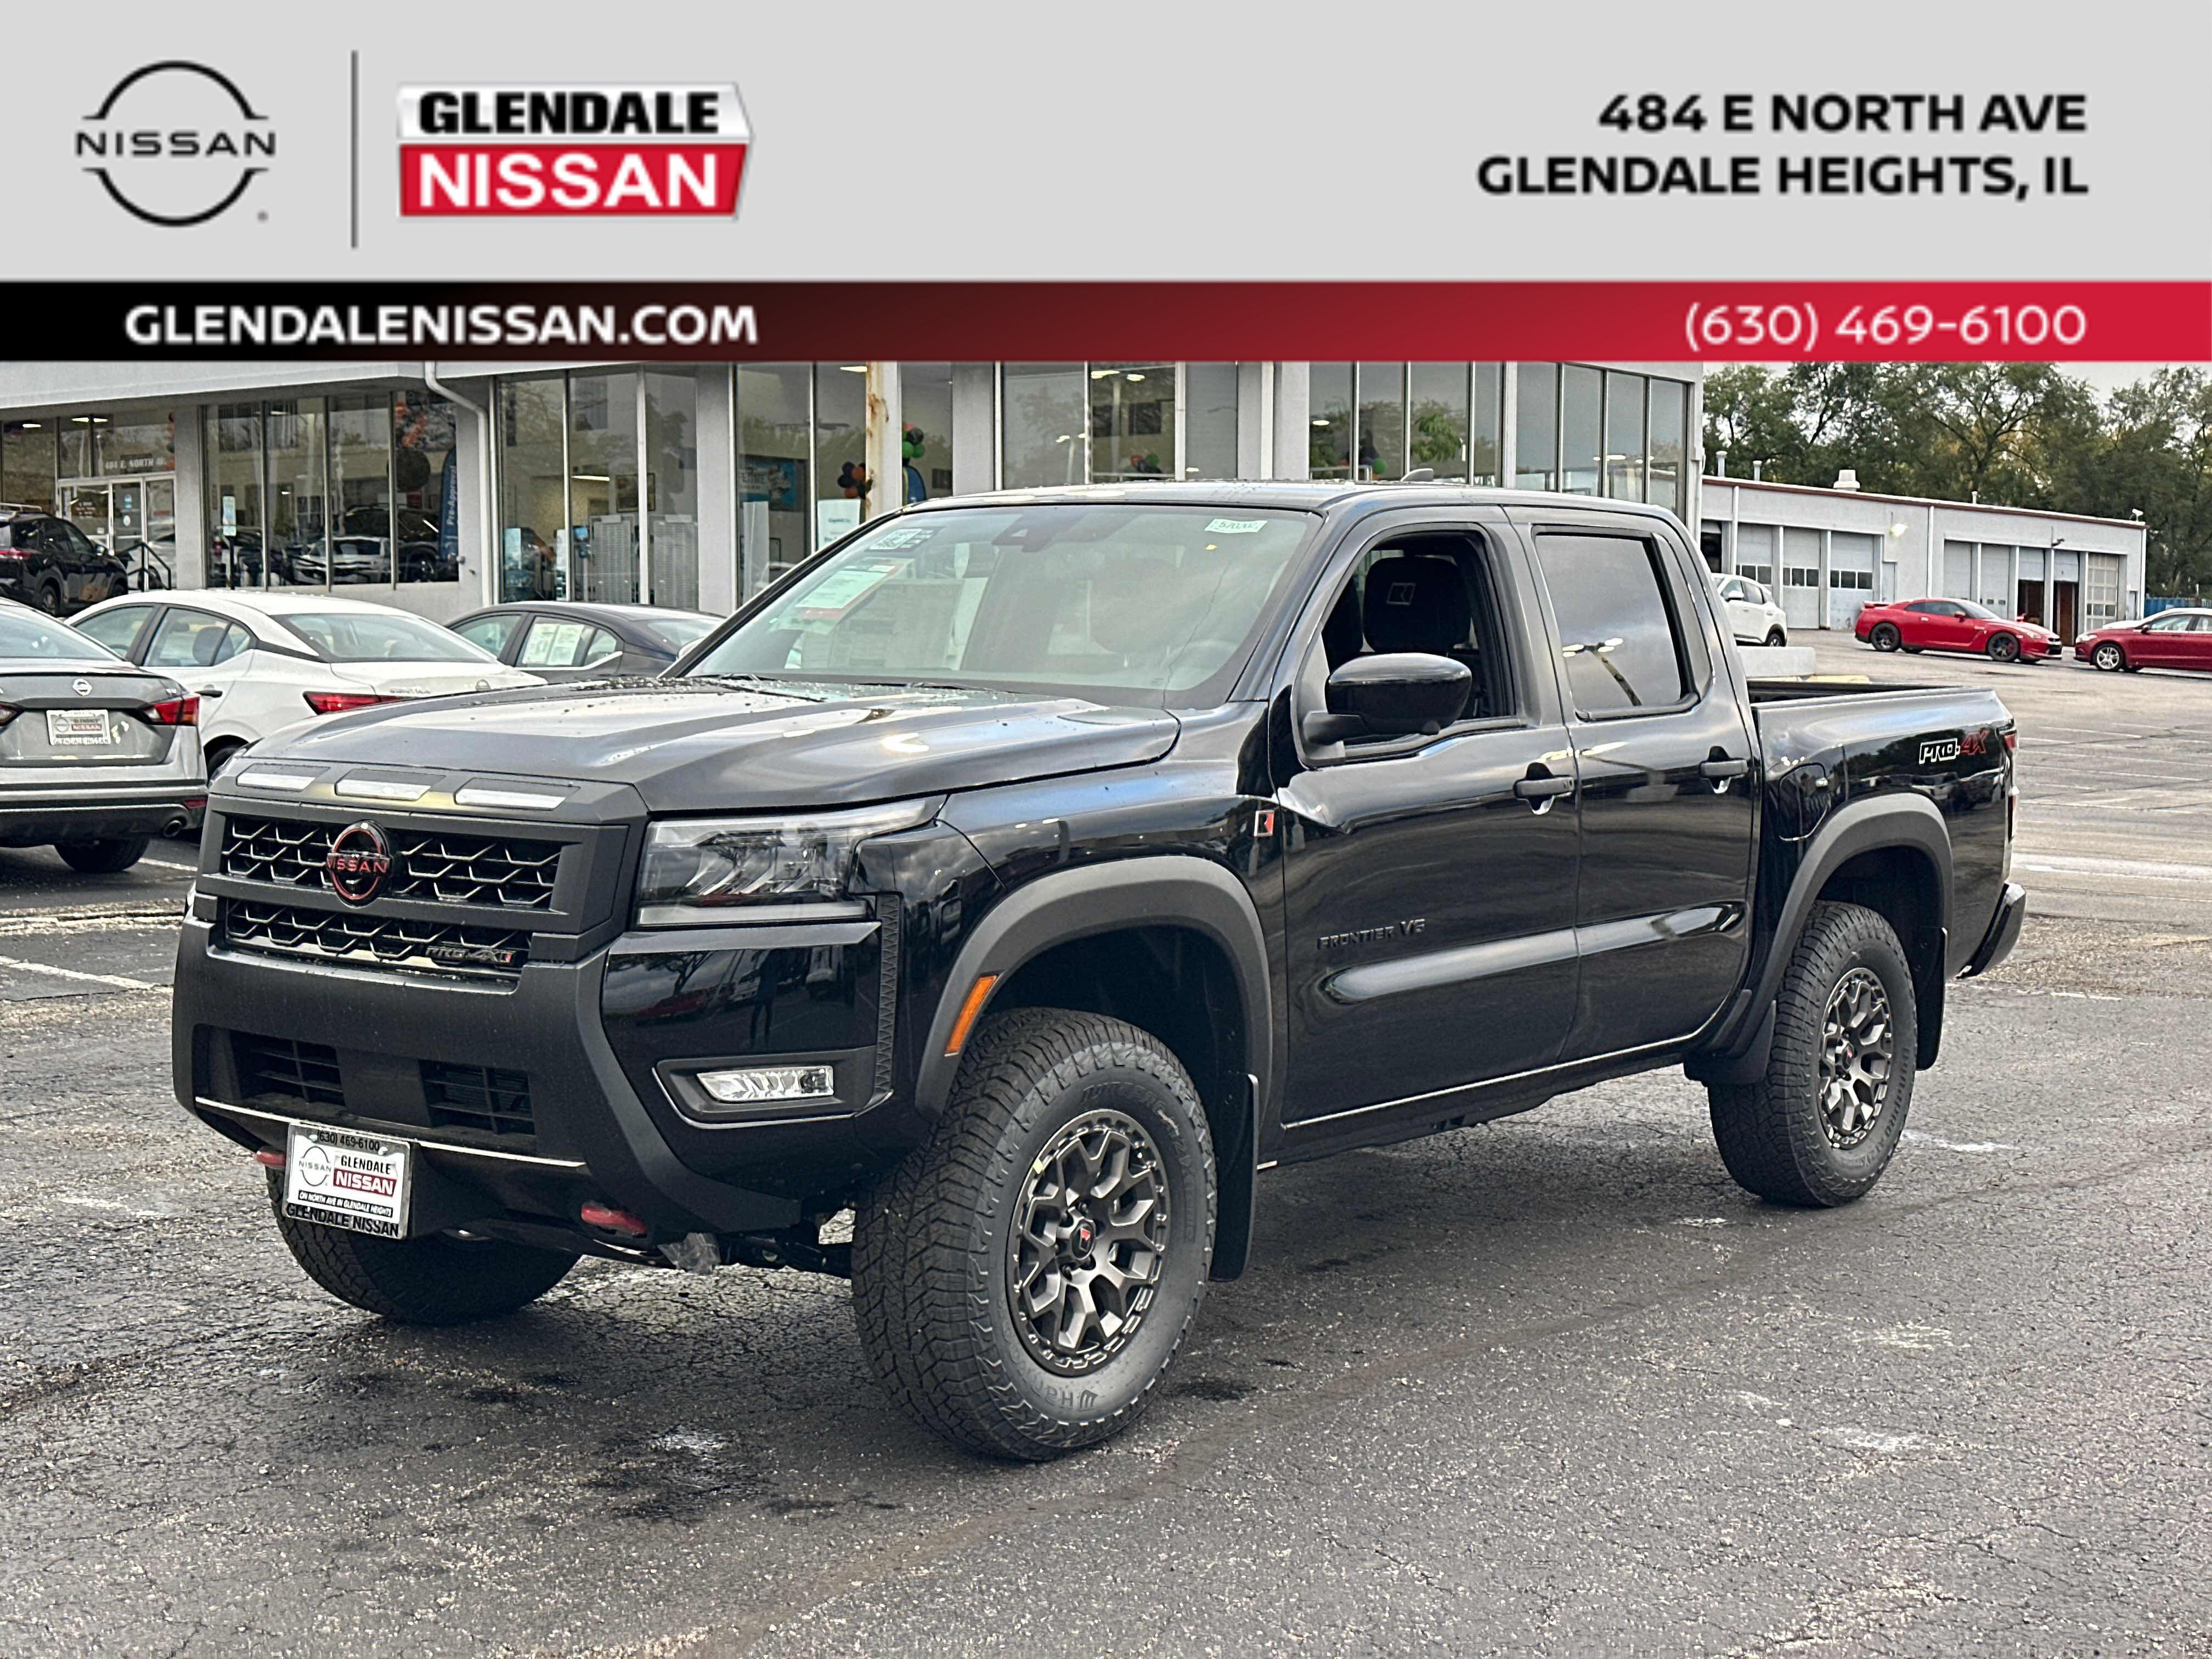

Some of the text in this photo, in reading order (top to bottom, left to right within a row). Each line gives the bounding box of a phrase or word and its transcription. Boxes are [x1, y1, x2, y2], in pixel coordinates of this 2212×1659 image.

[1317, 925, 1395, 950] FRONTIER
[317, 1130, 380, 1152] (630) 469-6100
[298, 1160, 331, 1172] NISSAN
[341, 1155, 391, 1175] GLENDALE
[335, 1169, 393, 1195] NISSAN
[299, 1190, 308, 1200] ON
[308, 1193, 326, 1204] NORTH
[343, 1200, 370, 1212] GLENDALE
[287, 1203, 399, 1237] GLENDALE NISSAN
